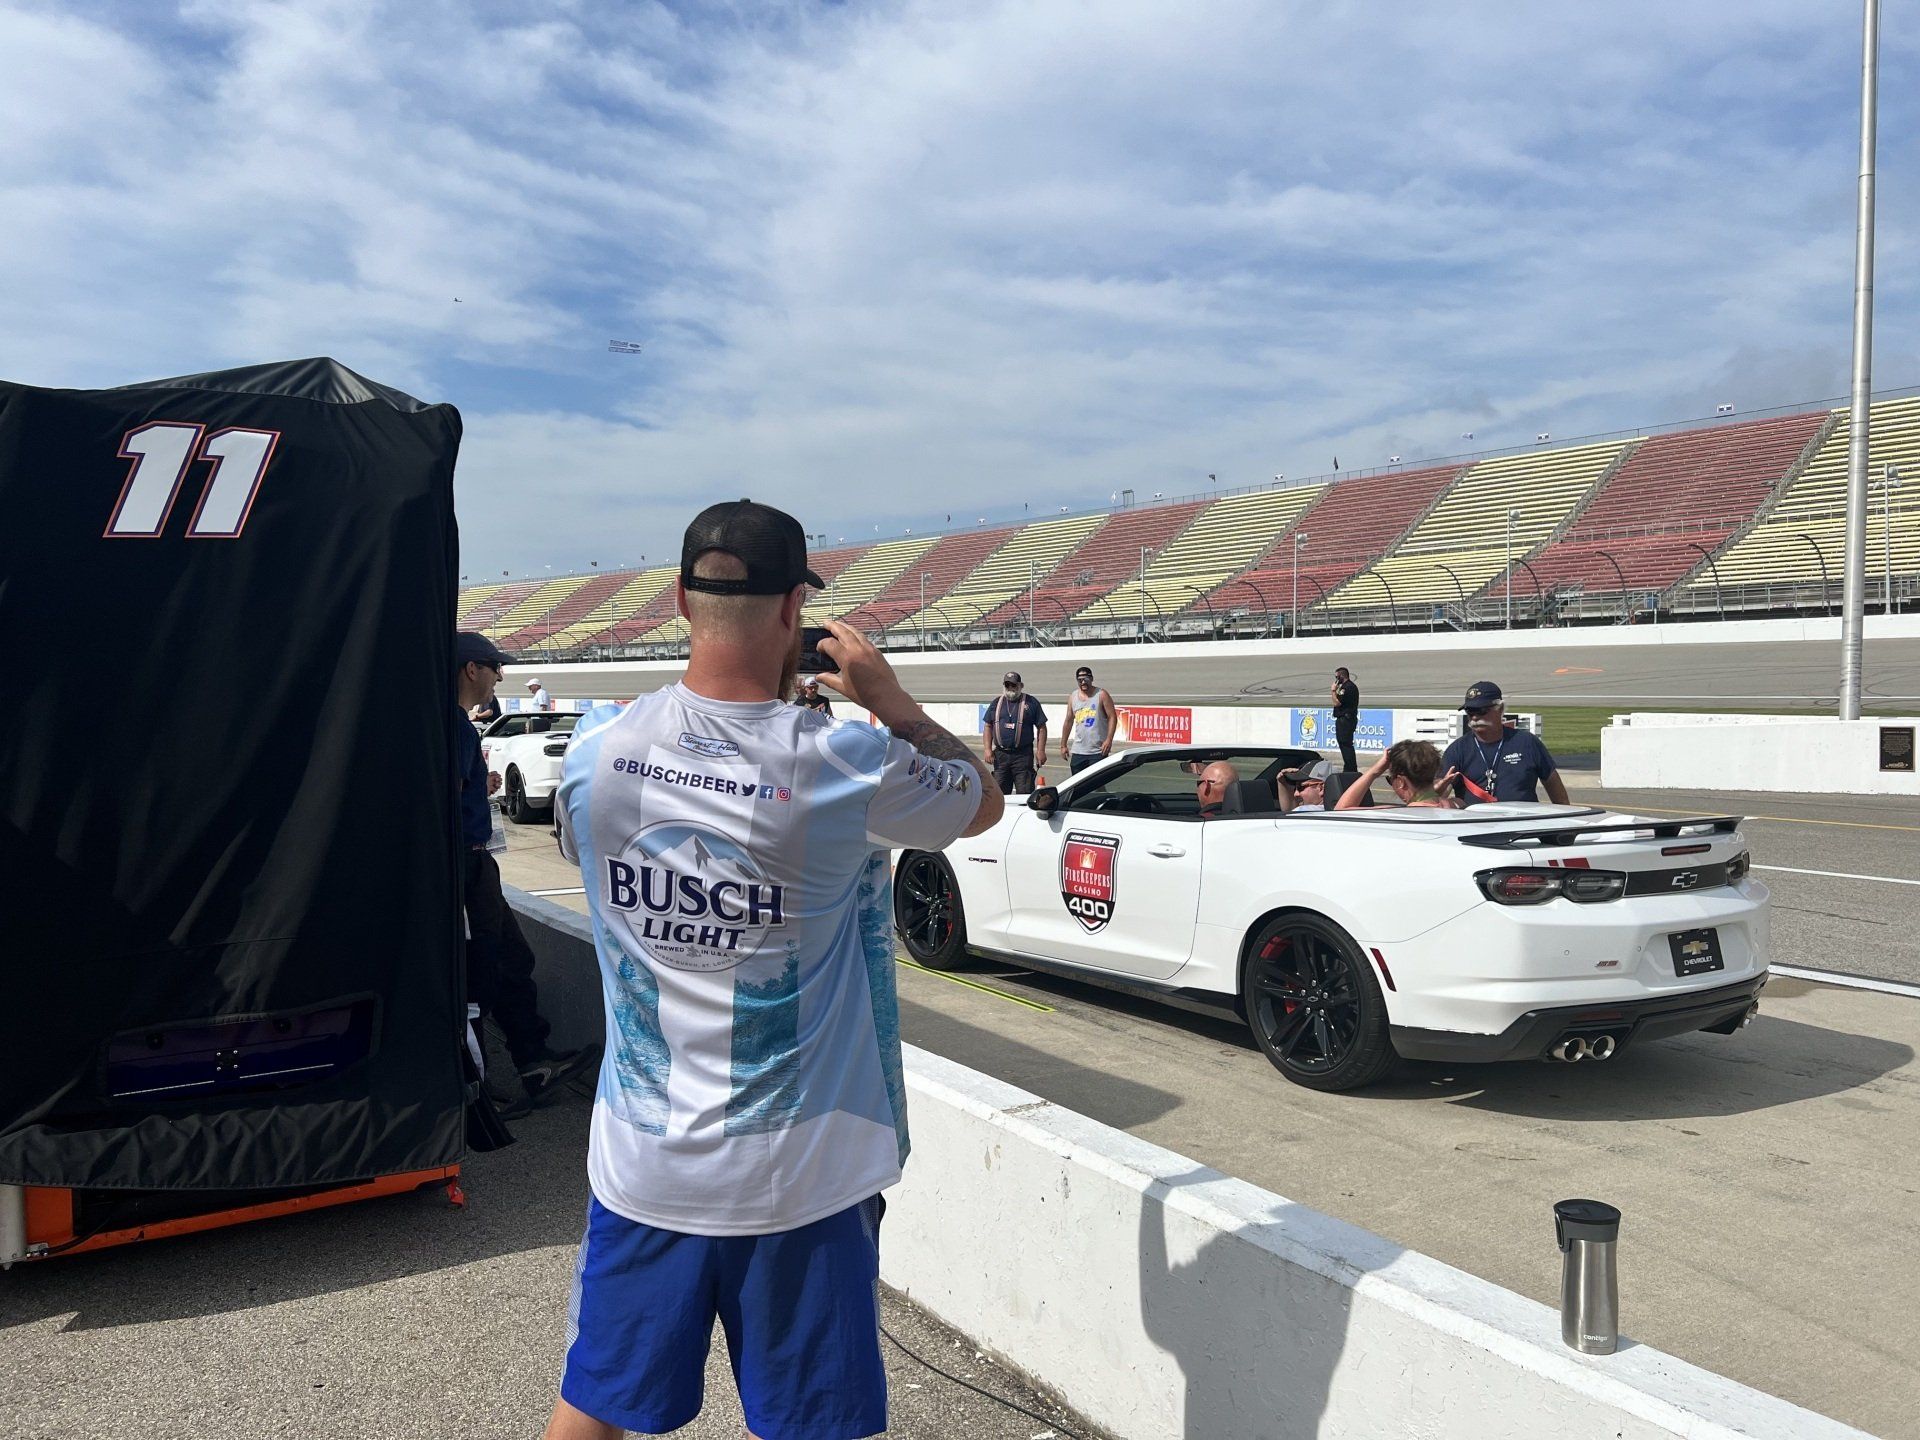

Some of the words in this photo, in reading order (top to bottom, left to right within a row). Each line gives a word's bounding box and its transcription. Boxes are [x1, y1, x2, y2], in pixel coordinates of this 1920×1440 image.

[103, 421, 281, 538] 11
[1353, 725, 1386, 735] HOOLS.
[1297, 740, 1319, 748] LOTTERY
[1356, 738, 1386, 749] YEARS.
[613, 757, 738, 796] @BUSCHBEER
[606, 857, 785, 925] BUSCH
[1073, 884, 1102, 897] CASINO
[1068, 896, 1109, 919] 400
[641, 917, 745, 950] LIGHT
[654, 944, 685, 953] BREWED
[1683, 955, 1713, 966] CHEVROLET
